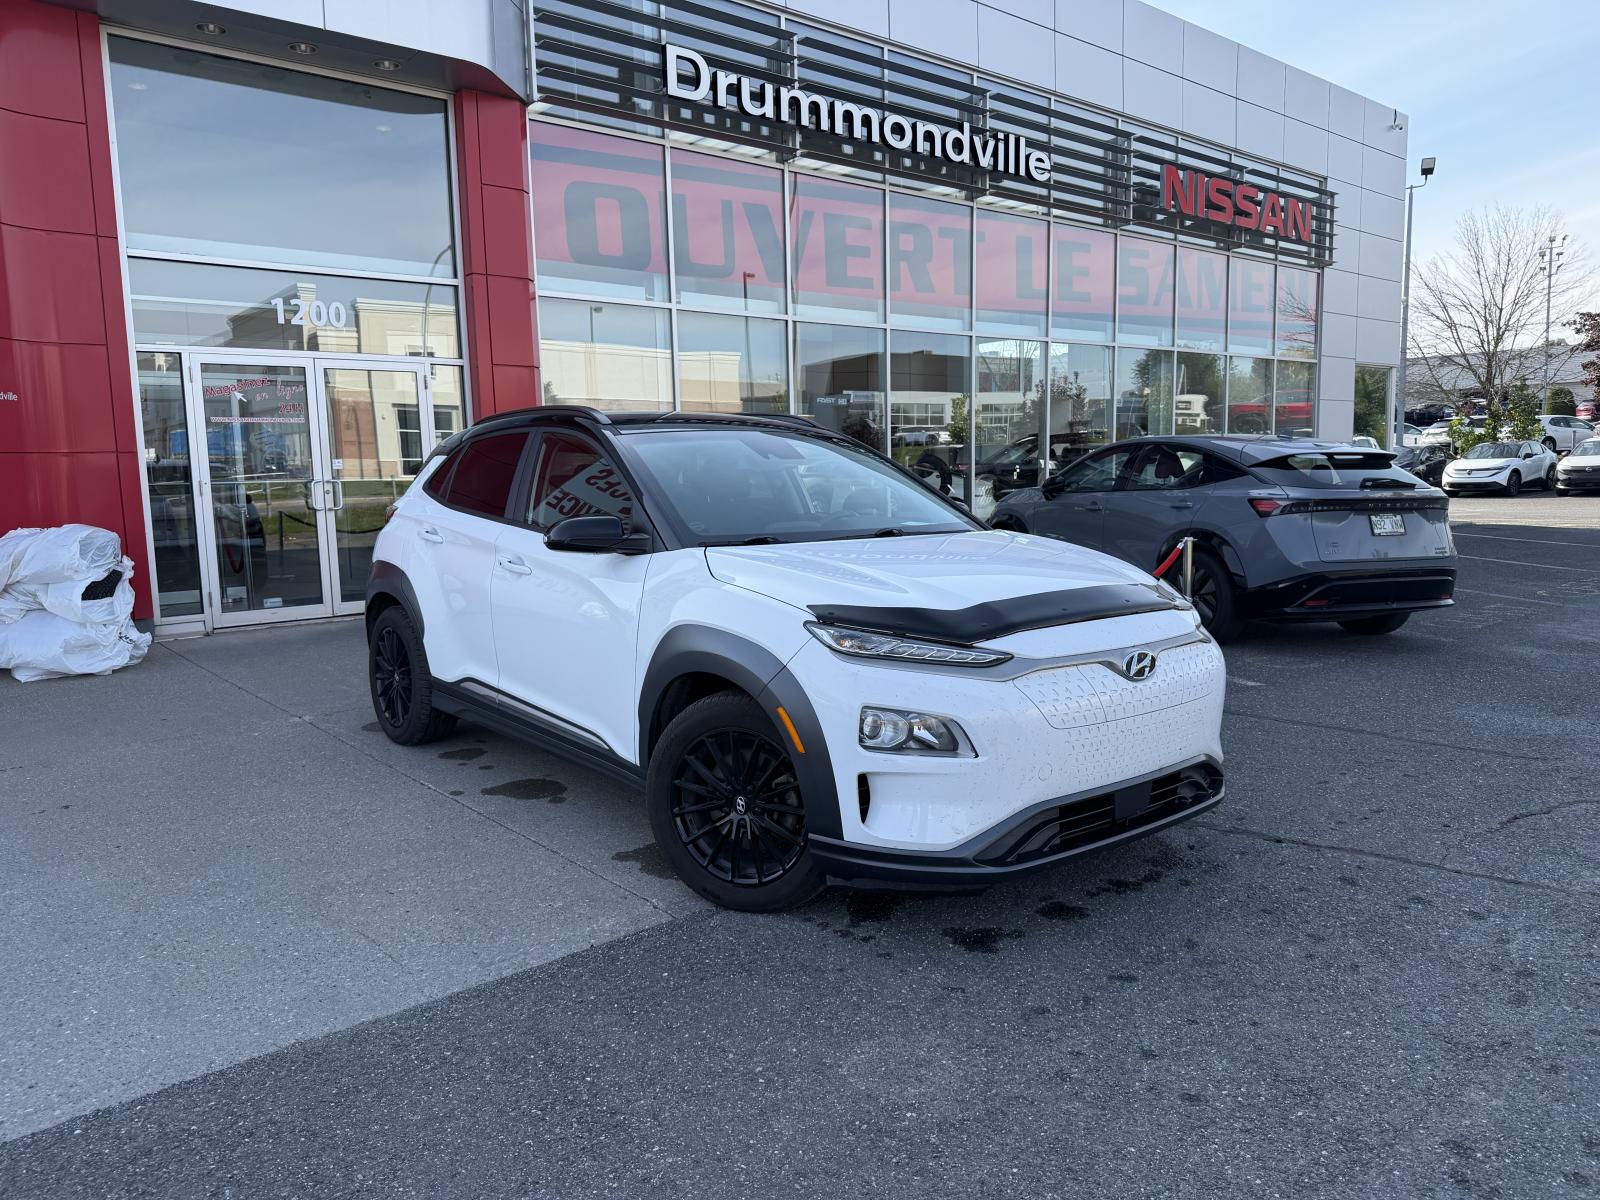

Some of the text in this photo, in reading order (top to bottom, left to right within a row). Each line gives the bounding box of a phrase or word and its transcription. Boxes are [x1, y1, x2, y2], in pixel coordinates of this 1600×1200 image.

[663, 43, 1052, 182] Drummondville
[563, 180, 1309, 314] OUVERT LE SAMEDI
[1160, 164, 1312, 242] NISSAN
[271, 297, 347, 328] 1200
